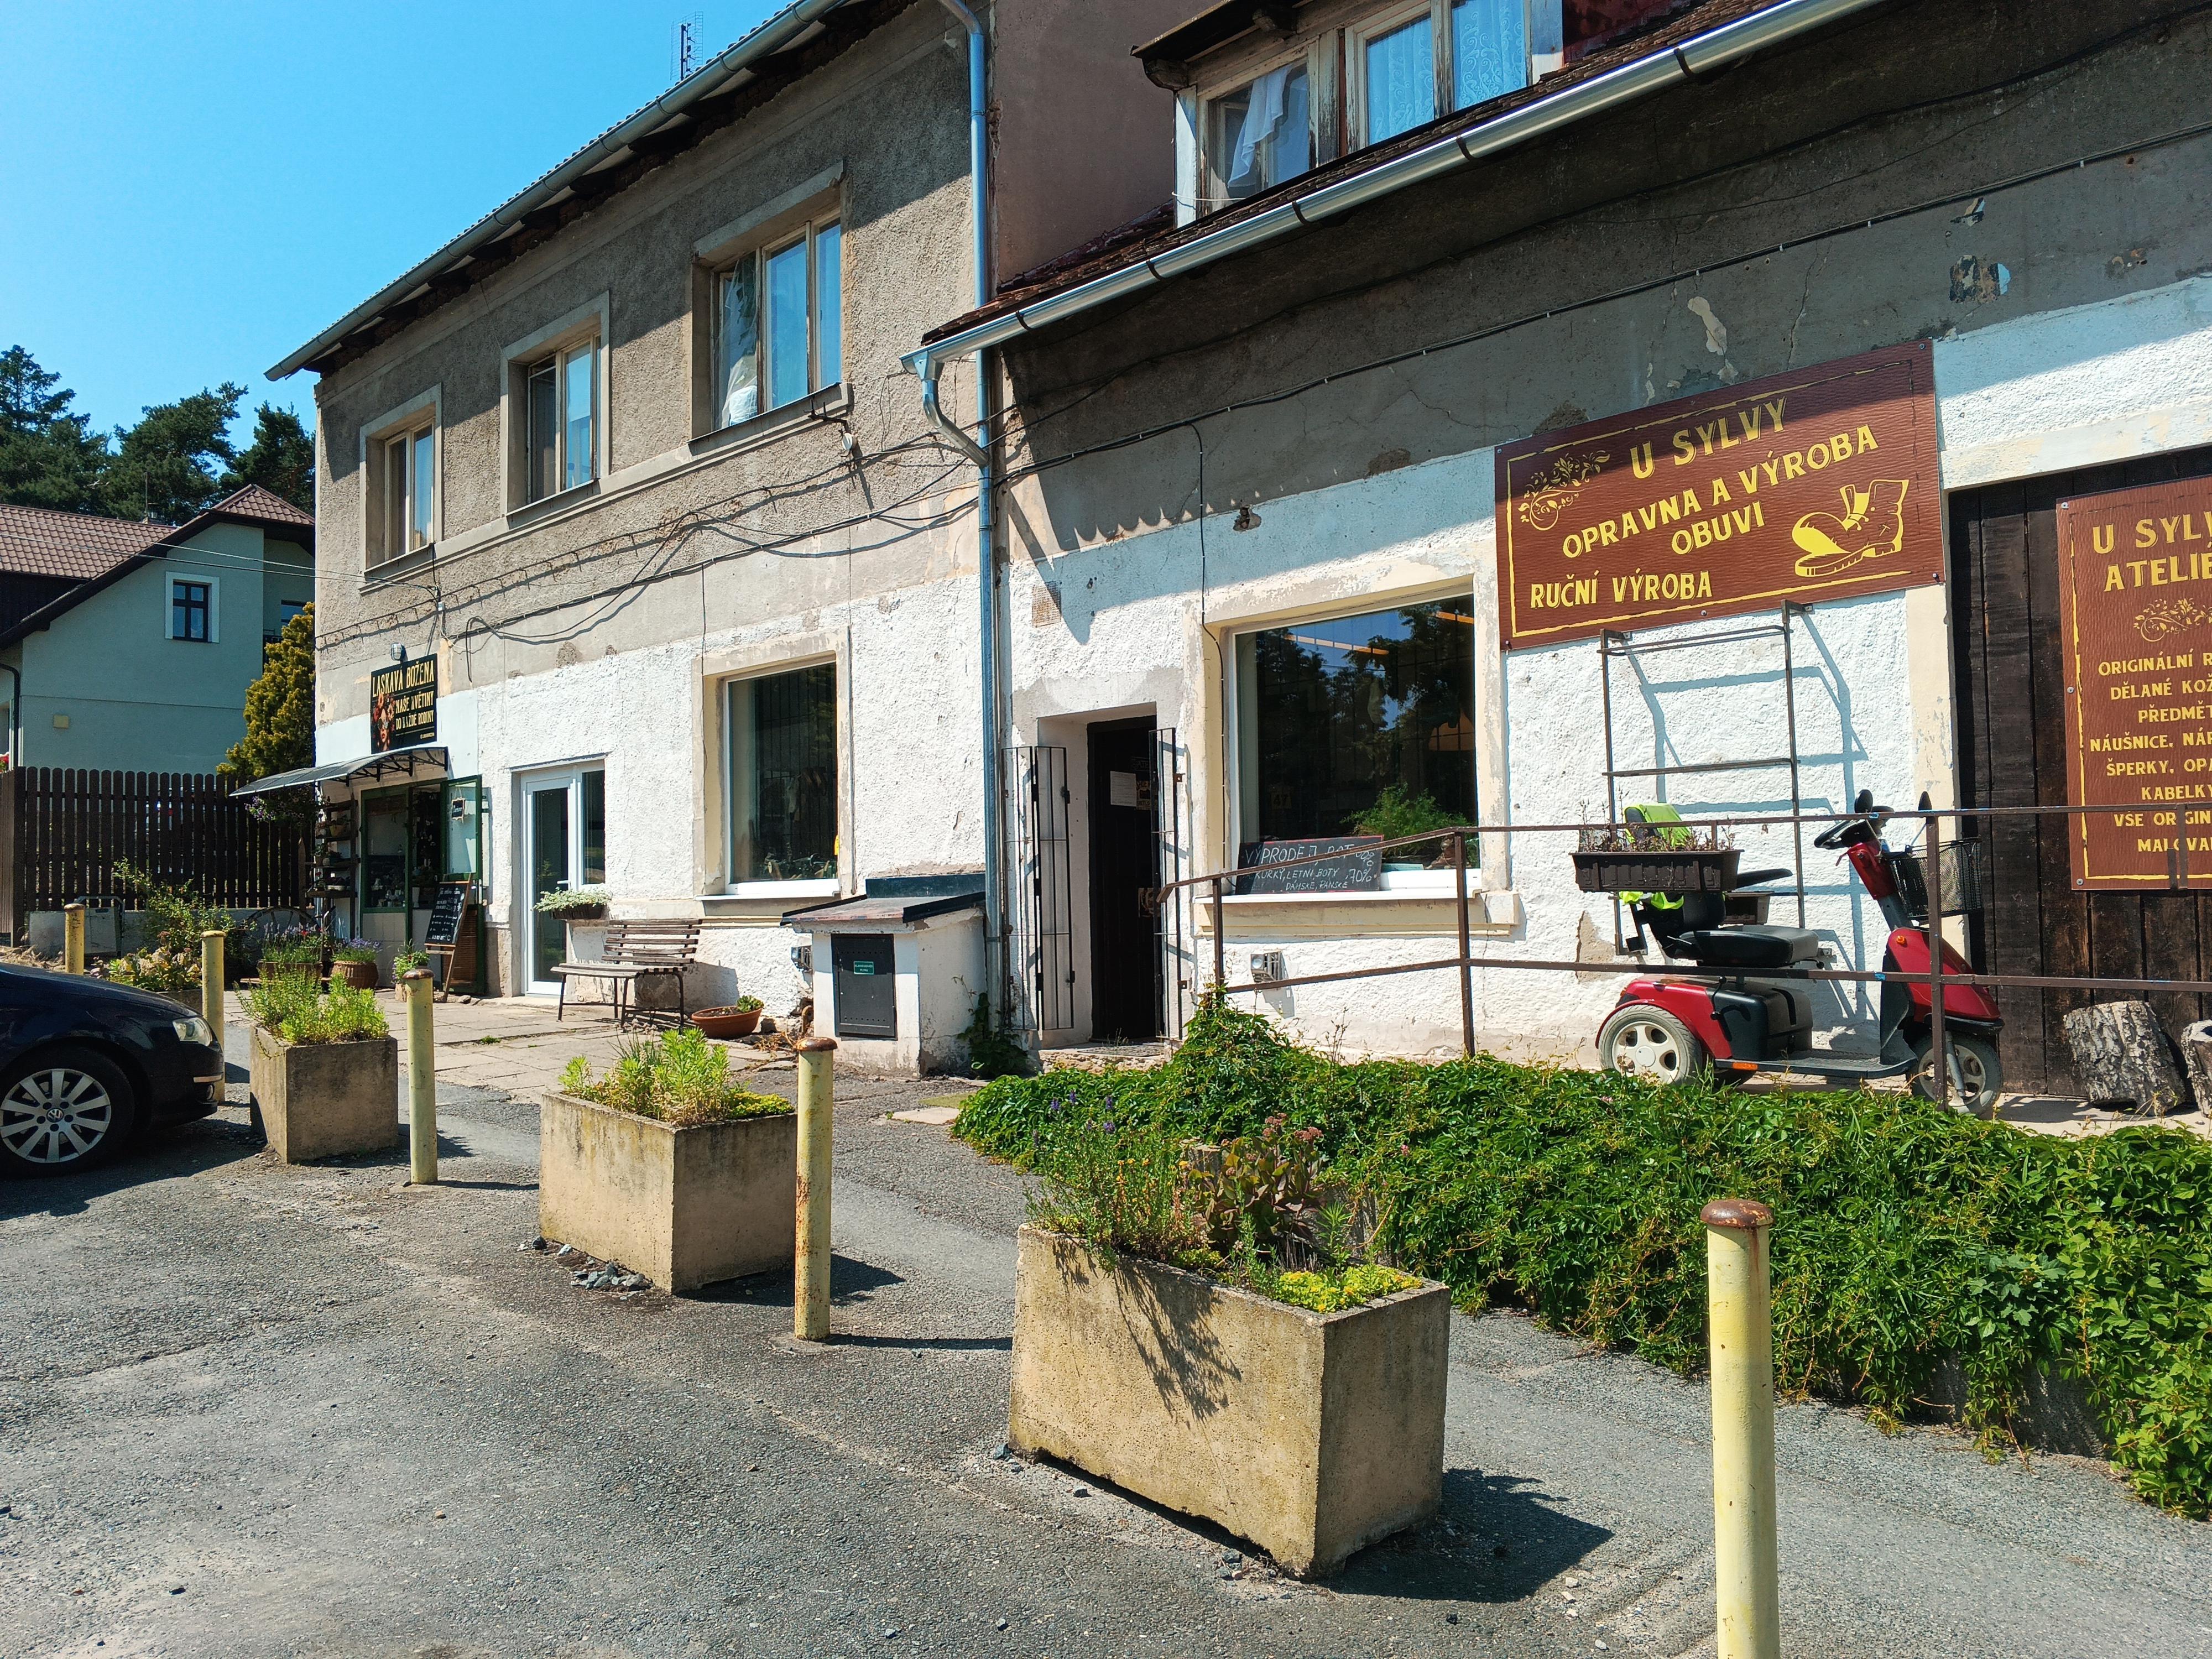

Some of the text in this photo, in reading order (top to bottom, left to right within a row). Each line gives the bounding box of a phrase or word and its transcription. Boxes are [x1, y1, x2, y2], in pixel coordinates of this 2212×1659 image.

[1630, 397, 1787, 479] U SYLVY
[1562, 424, 1879, 558] OPRAVNA A VÝROBA
[1671, 500, 1766, 555] OBUVI
[2093, 523, 2115, 554] U
[1531, 568, 1712, 609] RUČNÍ VÝROBA
[2099, 648, 2193, 676] ORIGINÁLNÍ
[373, 661, 434, 697] LASKAVÁ BOŽENA
[2110, 677, 2172, 700] DĚLANÉ
[395, 691, 434, 714] NAŠE KVĚTINY
[395, 718, 401, 730] DO
[418, 710, 434, 725] RODINY
[2153, 811, 2211, 826] ORGIN
